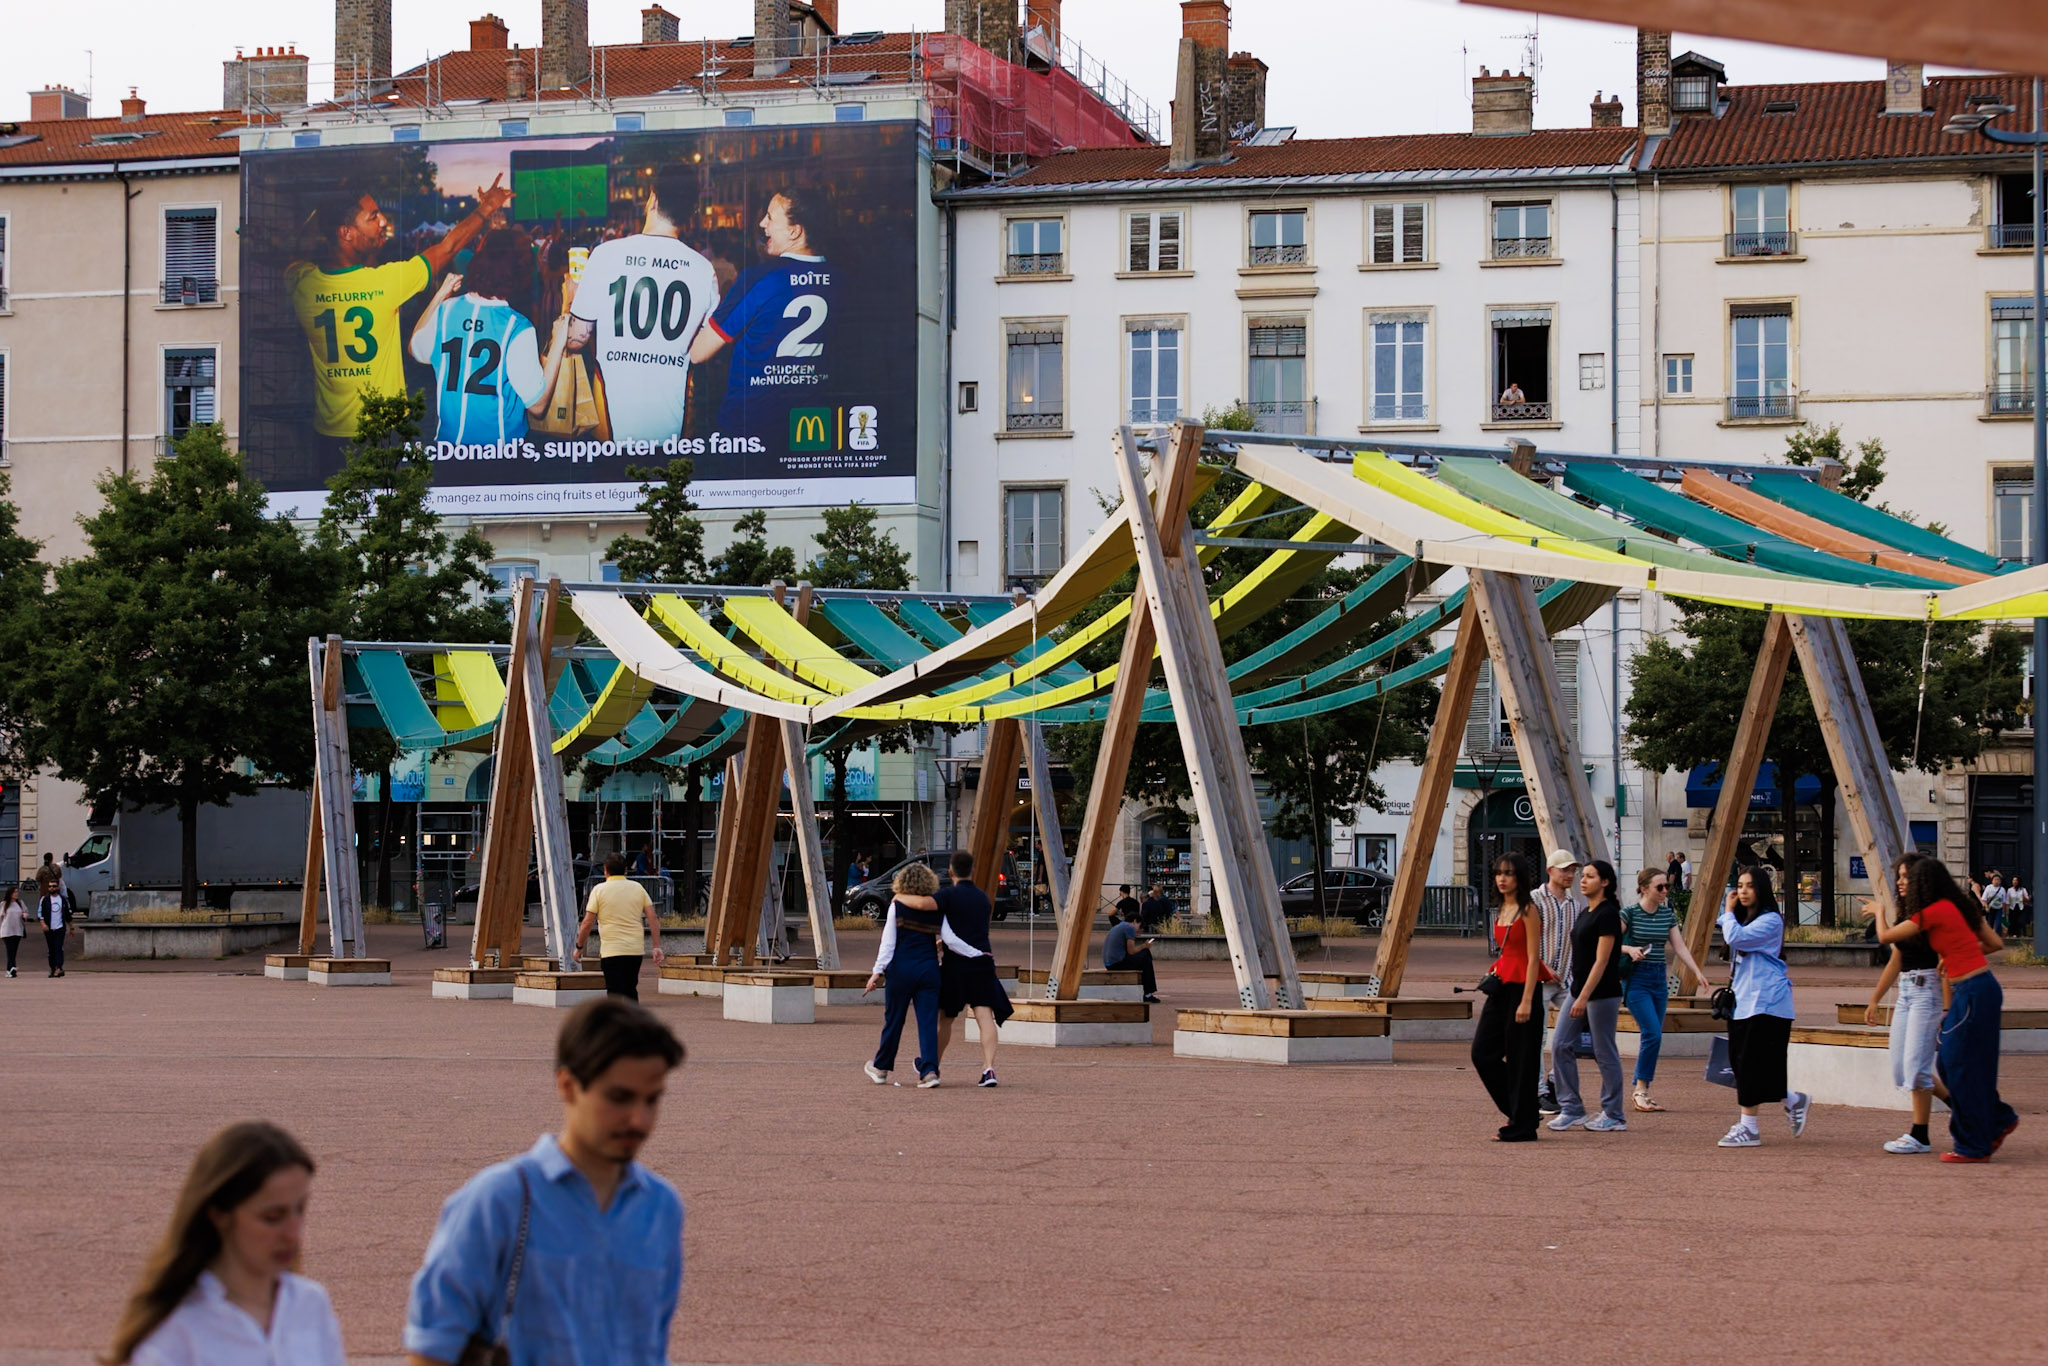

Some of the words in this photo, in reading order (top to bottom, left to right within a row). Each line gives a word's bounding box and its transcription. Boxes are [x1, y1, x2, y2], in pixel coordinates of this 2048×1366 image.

[625, 255, 647, 267] BIG
[790, 271, 831, 286] BOÎTE
[608, 275, 692, 341] 100
[314, 305, 378, 363] 13
[462, 318, 484, 332] CB
[776, 294, 829, 358] 2
[441, 336, 502, 396] 12
[606, 350, 685, 368] CORNICHONS
[327, 364, 372, 378] ENTAMÉ
[763, 364, 816, 375] CHICKEN
[543, 436, 661, 463] supporter
[662, 433, 706, 456] des
[708, 431, 767, 454] fans.
[436, 493, 482, 506] mangez
[483, 492, 497, 503] au
[500, 489, 534, 503] moins
[536, 489, 561, 504] cinq
[563, 487, 592, 501] fruits
[594, 488, 606, 500] et
[684, 487, 705, 499] our.
[708, 486, 805, 498] www.mangerbouger.fr
